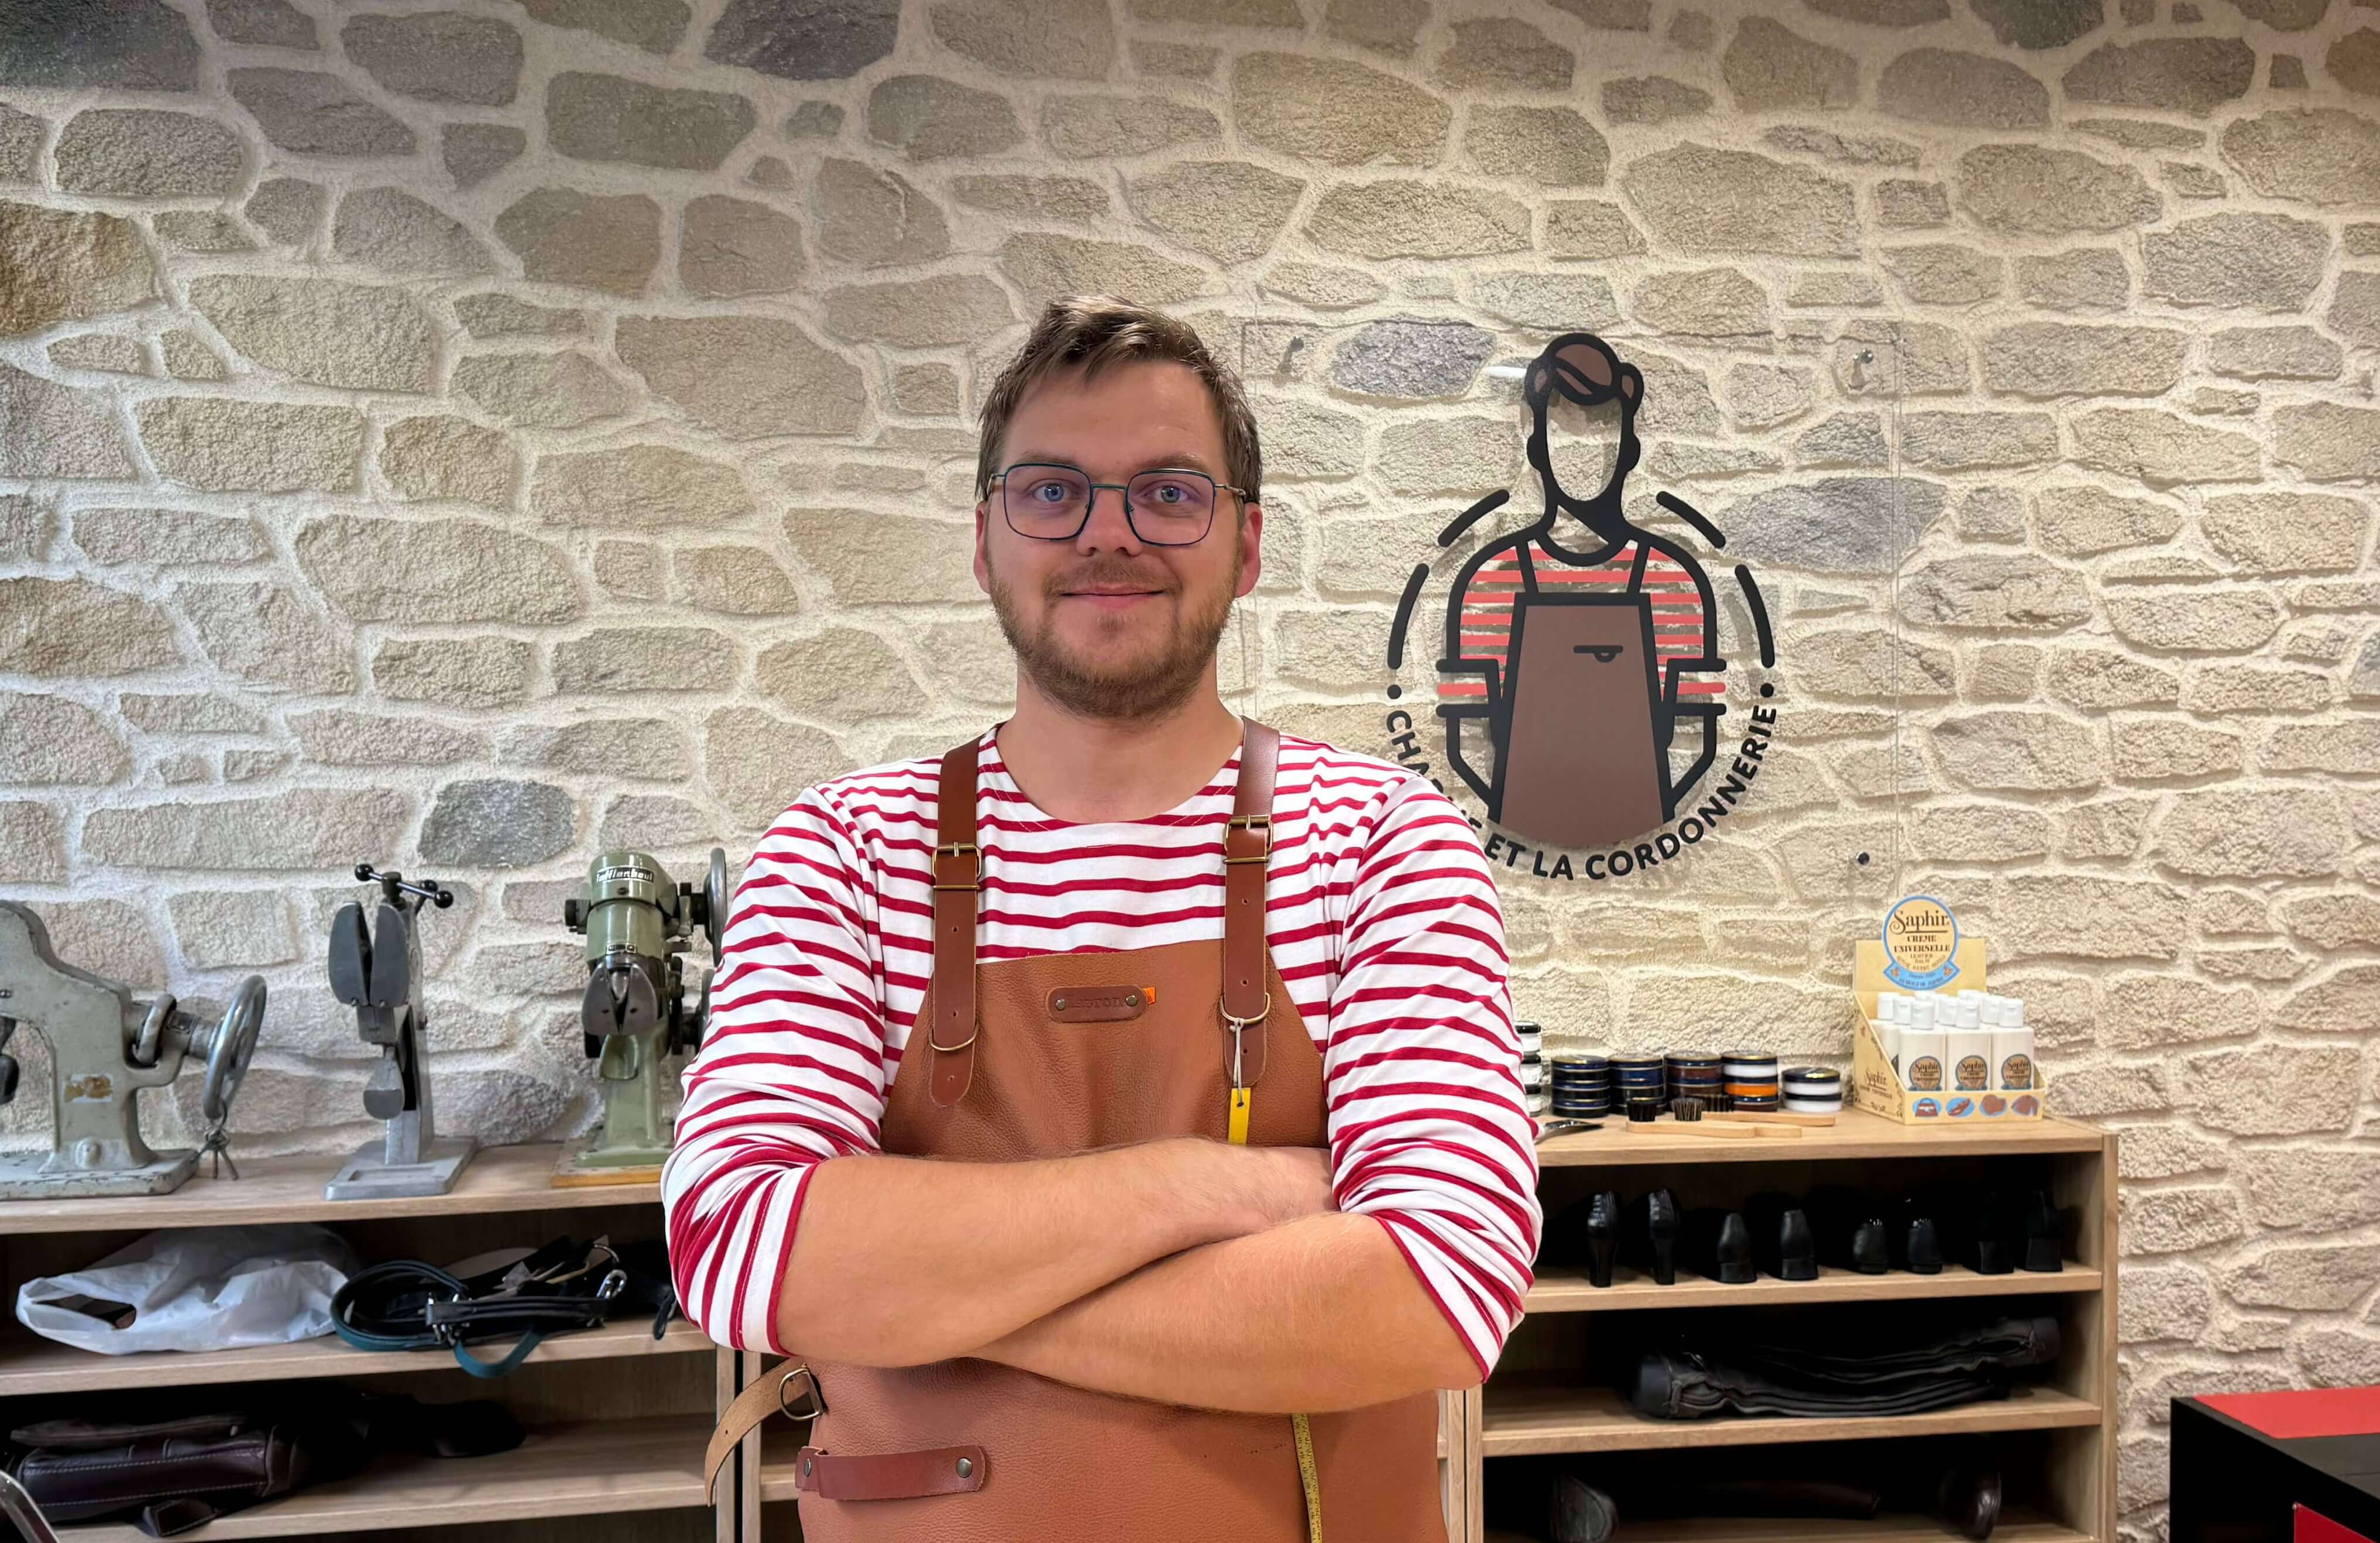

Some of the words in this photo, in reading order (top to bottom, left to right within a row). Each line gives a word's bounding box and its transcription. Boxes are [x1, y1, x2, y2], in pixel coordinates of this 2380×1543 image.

[1484, 833, 1526, 867] ET
[1533, 851, 1574, 880] LA
[1585, 705, 1777, 879] CORDONNERIE
[1889, 910, 1949, 935] Saphir
[1894, 944, 1950, 952] UNIVERSELLE
